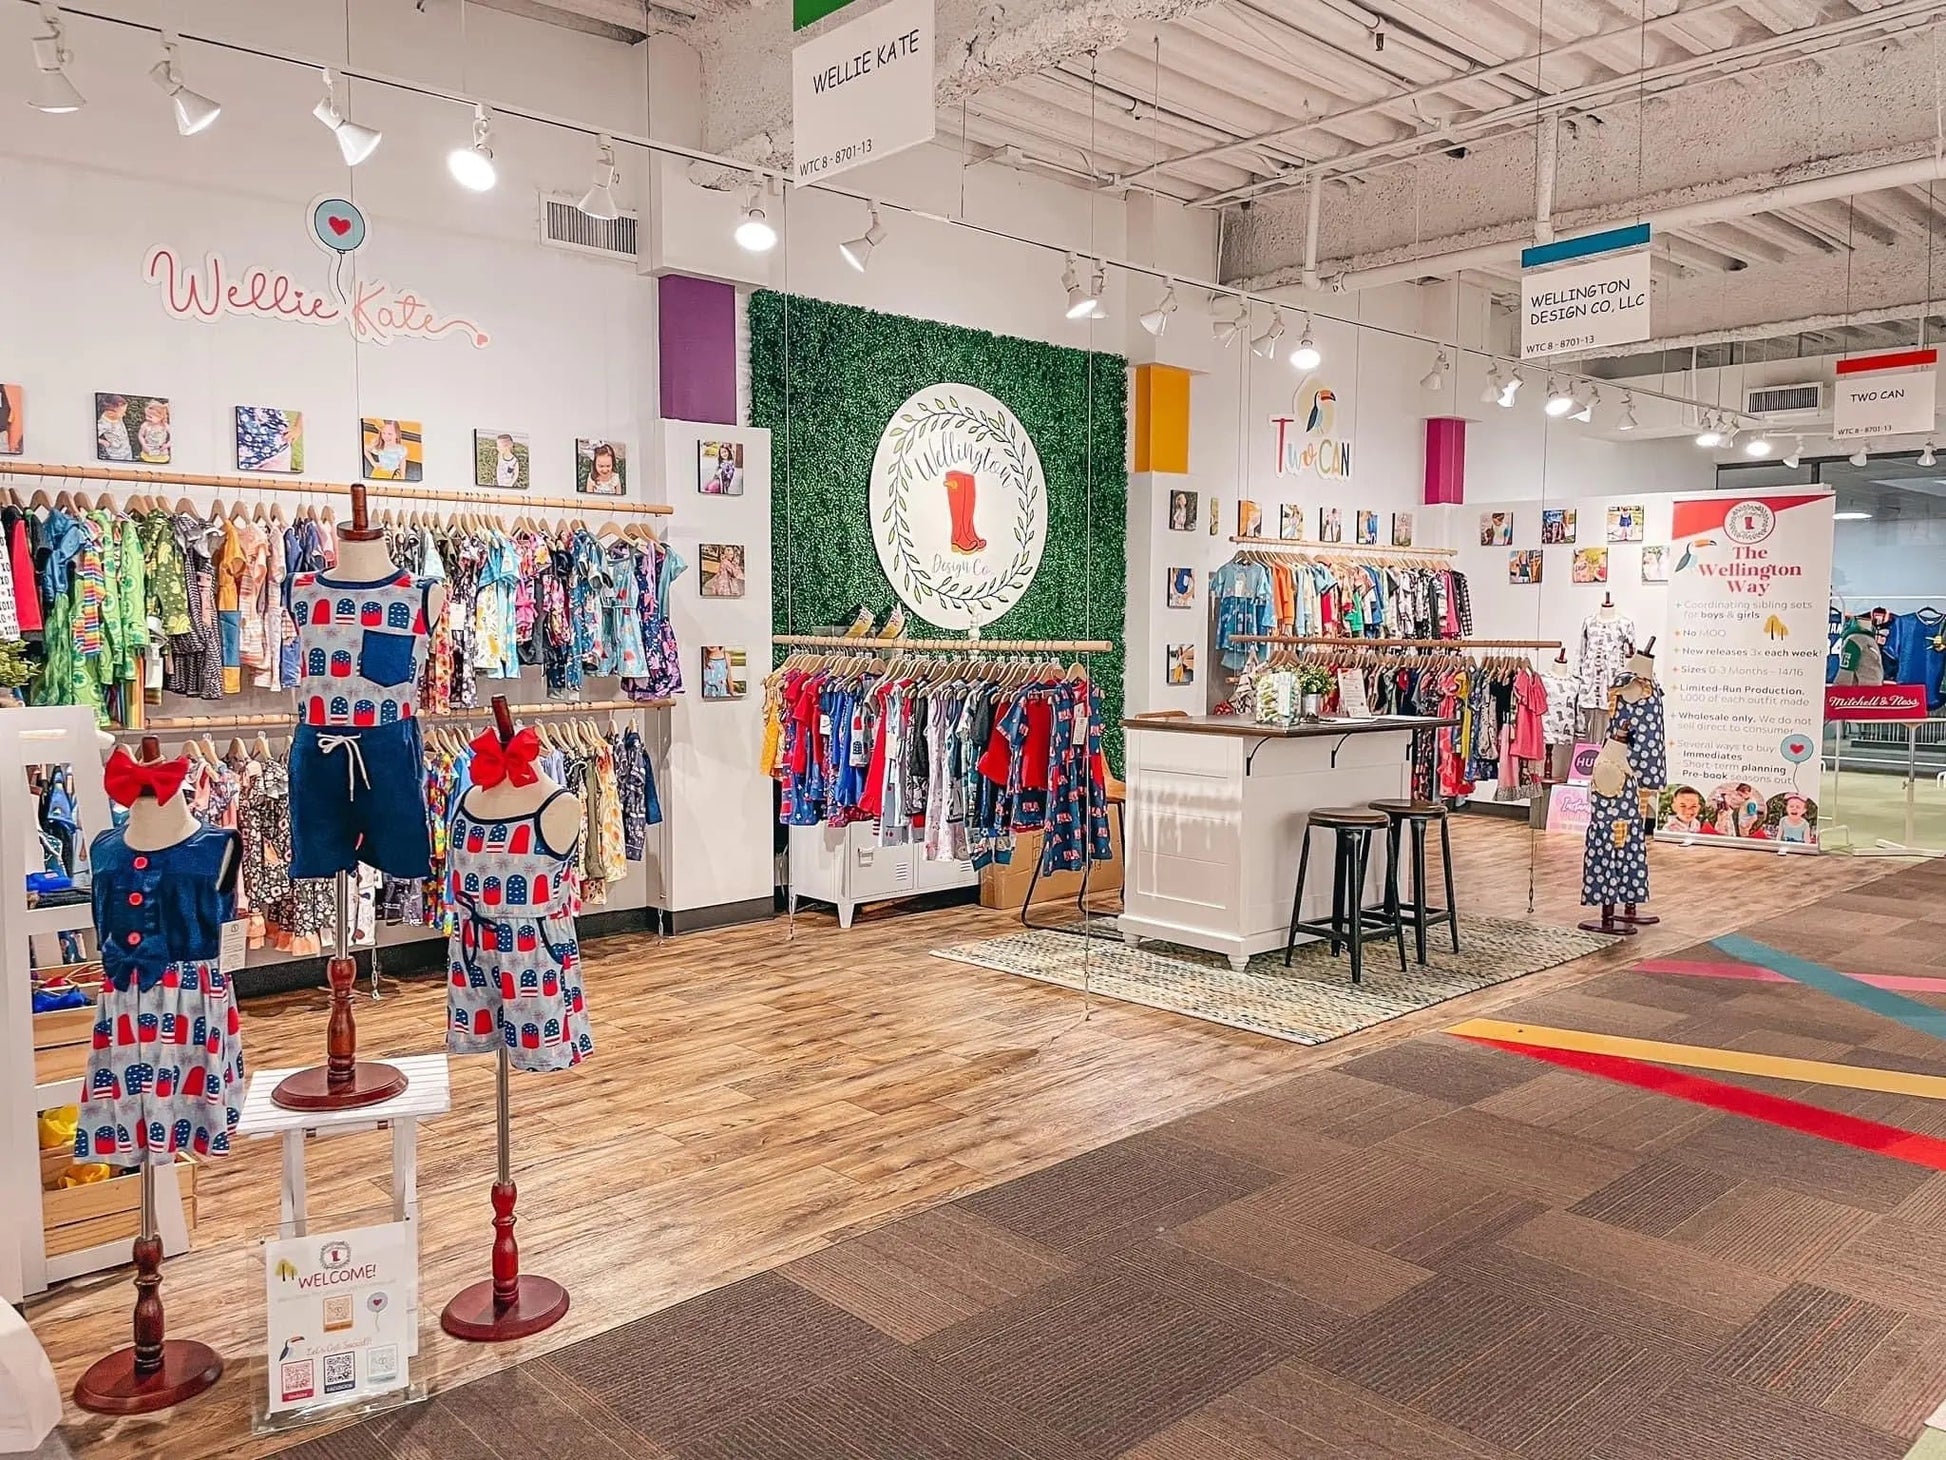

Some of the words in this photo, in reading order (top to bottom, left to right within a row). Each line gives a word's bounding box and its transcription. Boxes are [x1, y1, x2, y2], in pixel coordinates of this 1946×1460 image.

[813, 51, 871, 94] WELLIE
[877, 29, 919, 68] KATE
[800, 159, 821, 176] WTC
[822, 156, 828, 168] 8
[835, 139, 872, 164] 8701-13
[151, 251, 338, 318] Wellie
[352, 280, 477, 338] Kate
[1531, 278, 1630, 307] WELLINGTON
[1530, 304, 1587, 325] DESIGN
[1619, 294, 1645, 310] LLC
[1526, 342, 1547, 353] WTC
[1547, 342, 1553, 350] 8
[1560, 335, 1594, 347] 8701-13
[1850, 391, 1877, 402] TWO
[1880, 389, 1905, 399] CAN
[1271, 418, 1317, 473] Two
[1319, 438, 1350, 477] CAN
[914, 431, 1012, 488] Wellington
[1732, 546, 1768, 560] The
[932, 553, 971, 576] Design
[1699, 563, 1802, 580] Wellington
[1727, 580, 1771, 596] Way
[1684, 600, 1750, 610] Coordinating
[1752, 600, 1788, 611] sibling
[1790, 601, 1813, 609] sets
[1700, 611, 1724, 620] boys
[1737, 611, 1760, 621] girls
[1682, 647, 1703, 655] New
[1705, 648, 1748, 656] releases
[1764, 649, 1789, 657] each
[1681, 665, 1707, 674] Sizes
[1728, 666, 1768, 676] Months
[1680, 683, 1742, 693] Limited-Run
[1707, 694, 1718, 702] of
[1721, 695, 1745, 704] each
[1748, 696, 1777, 705] outfit
[1780, 697, 1810, 707] made
[1829, 695, 1878, 707] Mitchell
[1879, 696, 1889, 705] &
[1889, 695, 1919, 706] Ness
[1678, 712, 1729, 722] Wholesale
[1758, 715, 1775, 723] We
[1778, 716, 1792, 724] do
[1795, 717, 1812, 725] not
[1677, 721, 1694, 729] sell
[1696, 722, 1726, 731] direct
[1729, 724, 1741, 732] to
[1677, 739, 1713, 749] Several
[1716, 742, 1739, 751] ways
[1742, 744, 1753, 752] to
[1756, 744, 1776, 753] buy
[1683, 750, 1743, 761] Immediates
[1682, 769, 1728, 780] Pre-book
[1730, 774, 1772, 783] seasons
[1774, 776, 1793, 784] out
[1741, 763, 1787, 776] planning
[298, 1264, 376, 1288] WELCOME!
